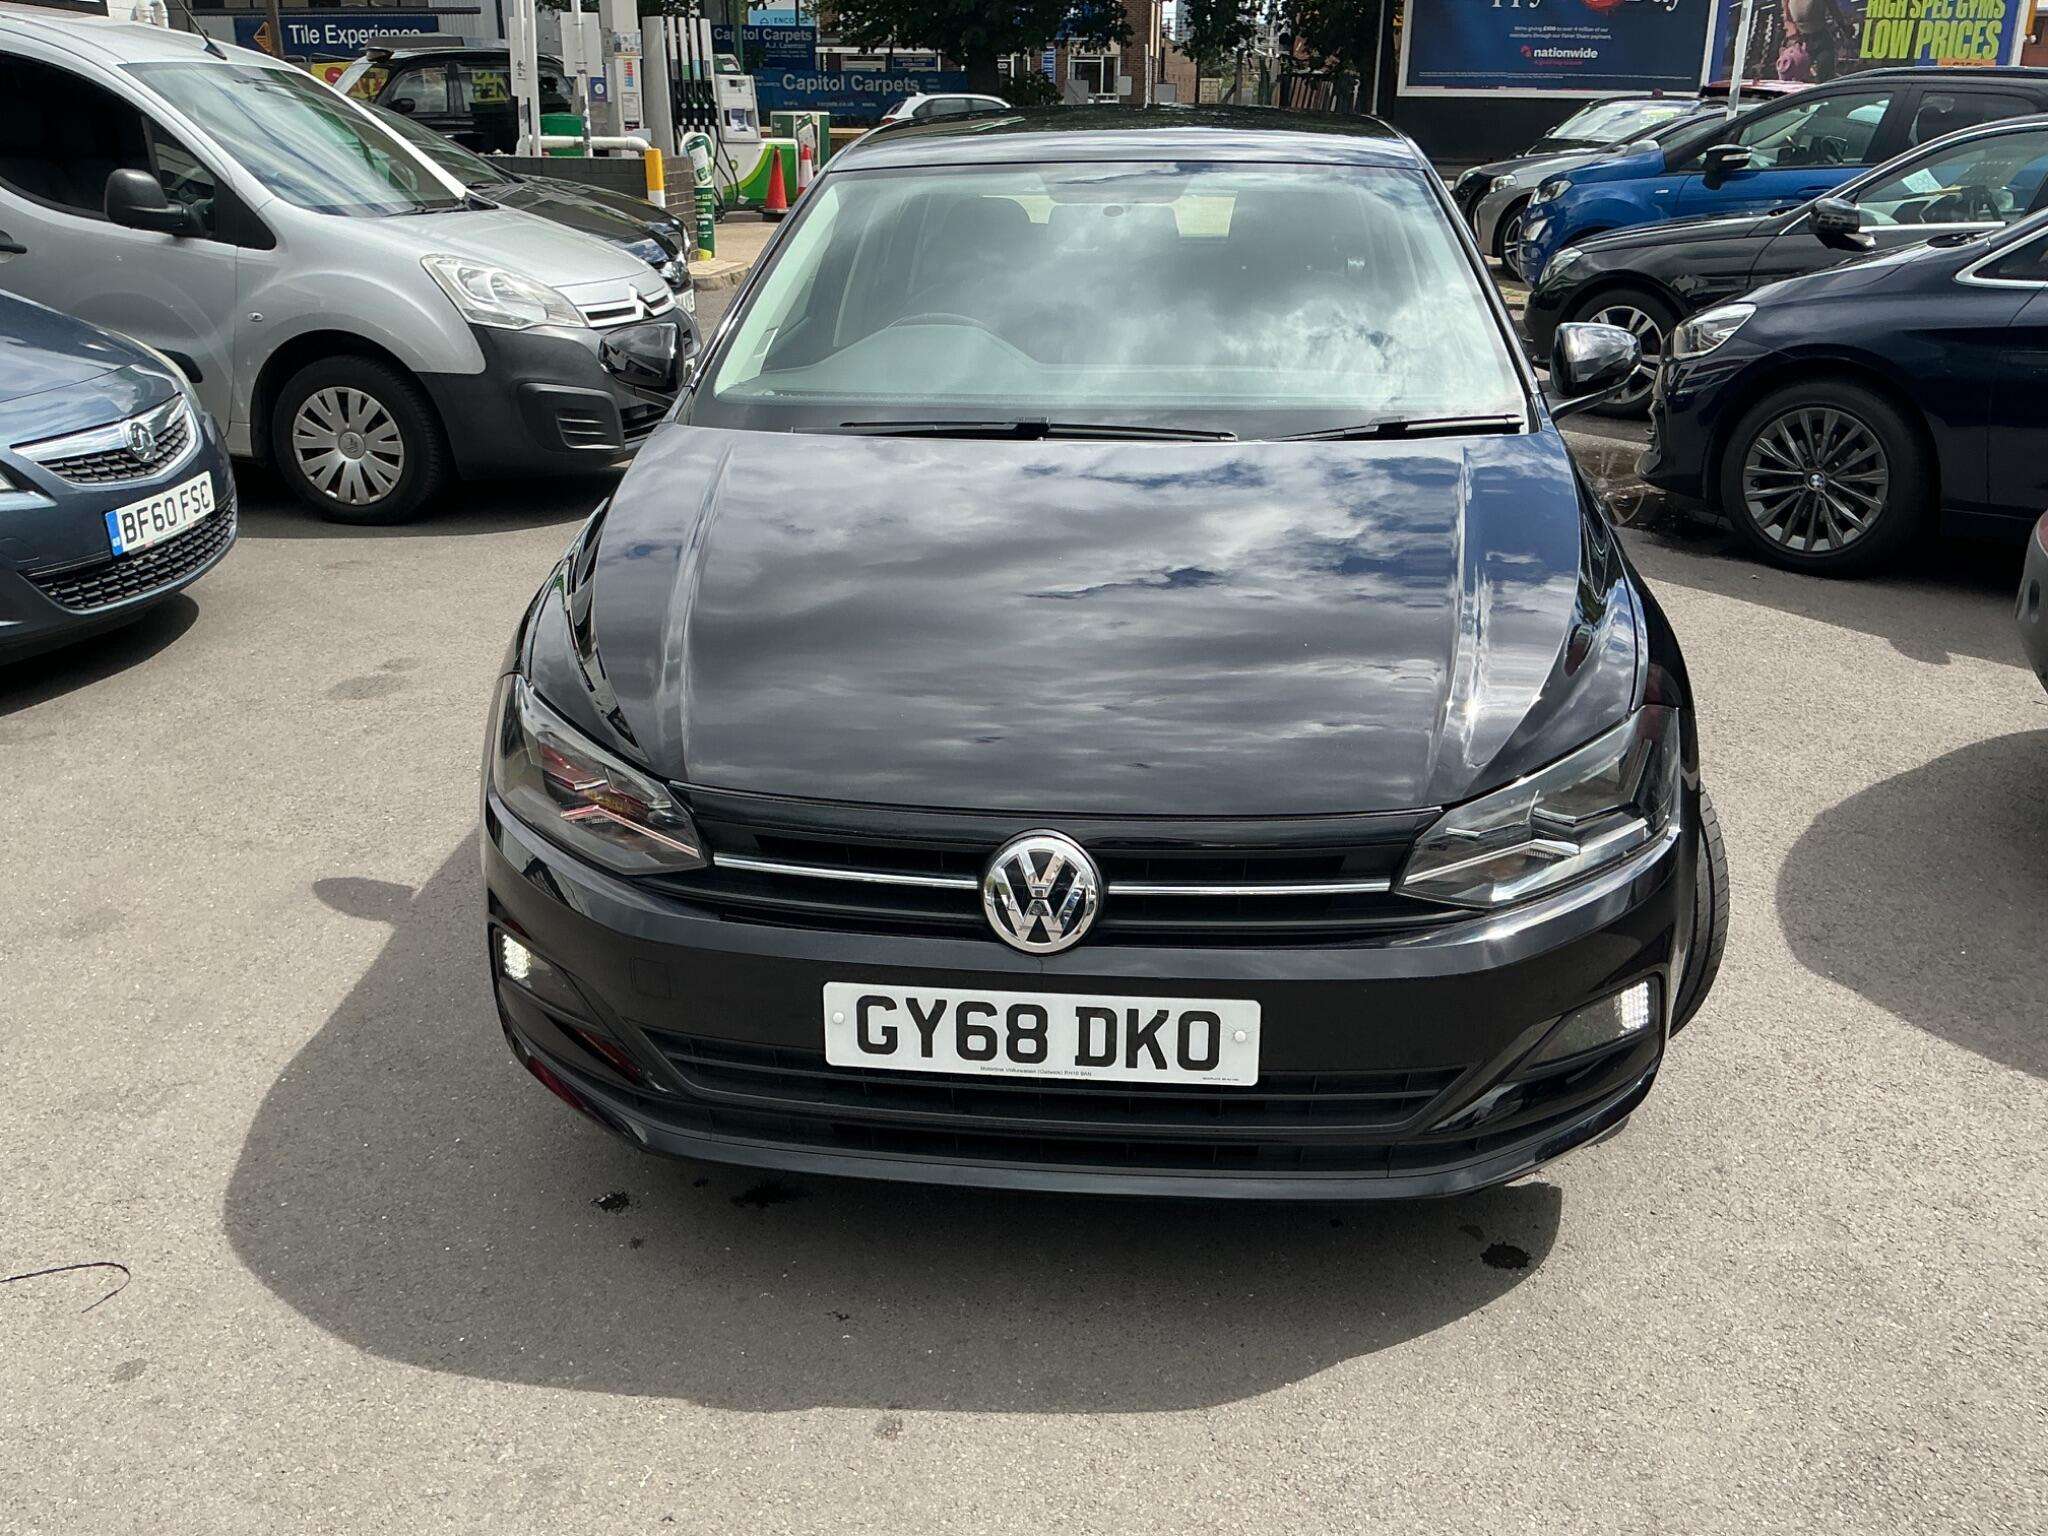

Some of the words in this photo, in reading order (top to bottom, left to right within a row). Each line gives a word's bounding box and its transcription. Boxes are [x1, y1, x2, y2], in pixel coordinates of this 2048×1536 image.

[1866, 0, 1908, 18] HIGH
[1909, 0, 1954, 18] SPEC
[1956, 0, 2006, 19] GYMS
[288, 24, 320, 44] Tile
[762, 28, 813, 42] Carpets
[1860, 19, 1915, 59] LOW
[1914, 20, 2002, 60] PRICES
[1533, 47, 1598, 58] nationwide
[782, 74, 845, 94] Capitol
[851, 74, 920, 95] Carpets
[121, 497, 178, 545] BF60
[180, 480, 210, 521] FSC
[856, 995, 1049, 1065] GY68
[1075, 1006, 1221, 1071] DKO
